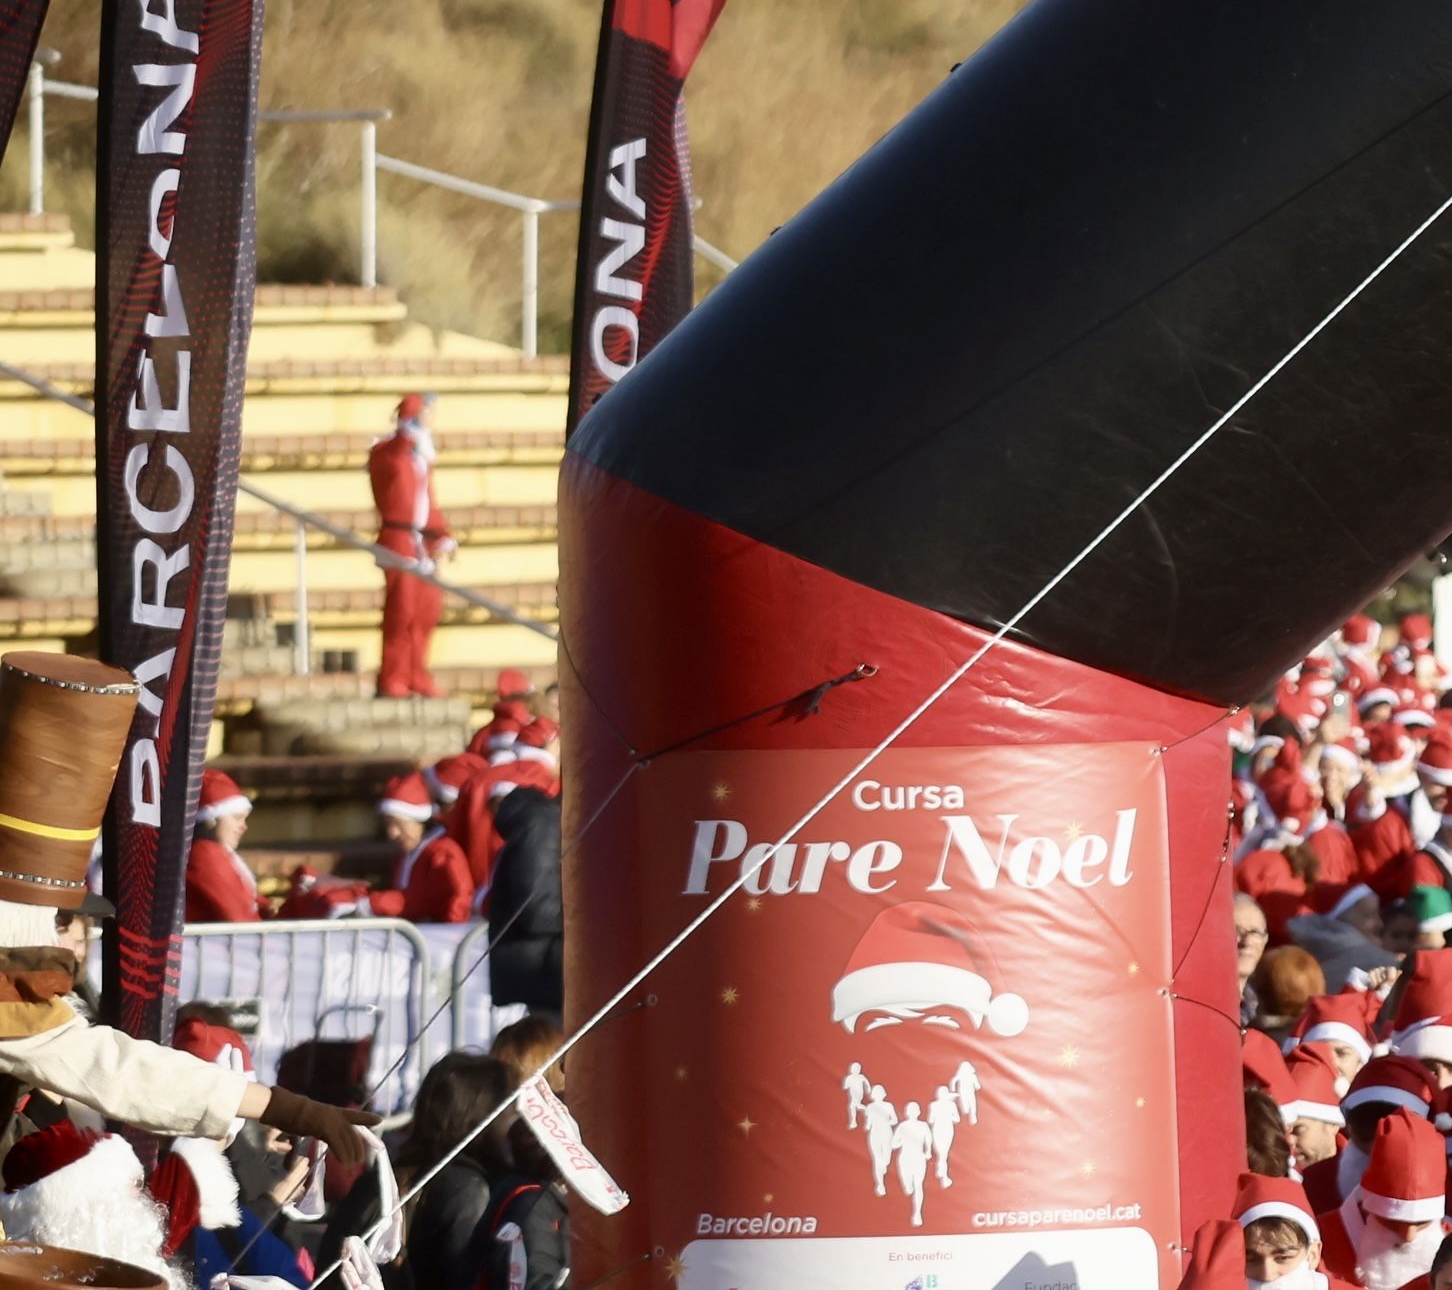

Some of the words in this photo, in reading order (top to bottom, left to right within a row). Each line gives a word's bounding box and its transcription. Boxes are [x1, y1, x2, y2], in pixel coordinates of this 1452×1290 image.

[853, 780, 965, 811] Cursa
[681, 820, 903, 895] Pare
[926, 809, 1137, 893] Noel
[697, 1212, 817, 1234] Barcelona
[972, 1203, 1141, 1227] cursaparenoel.cat
[889, 1253, 903, 1261] En
[907, 1252, 953, 1262] benefici
